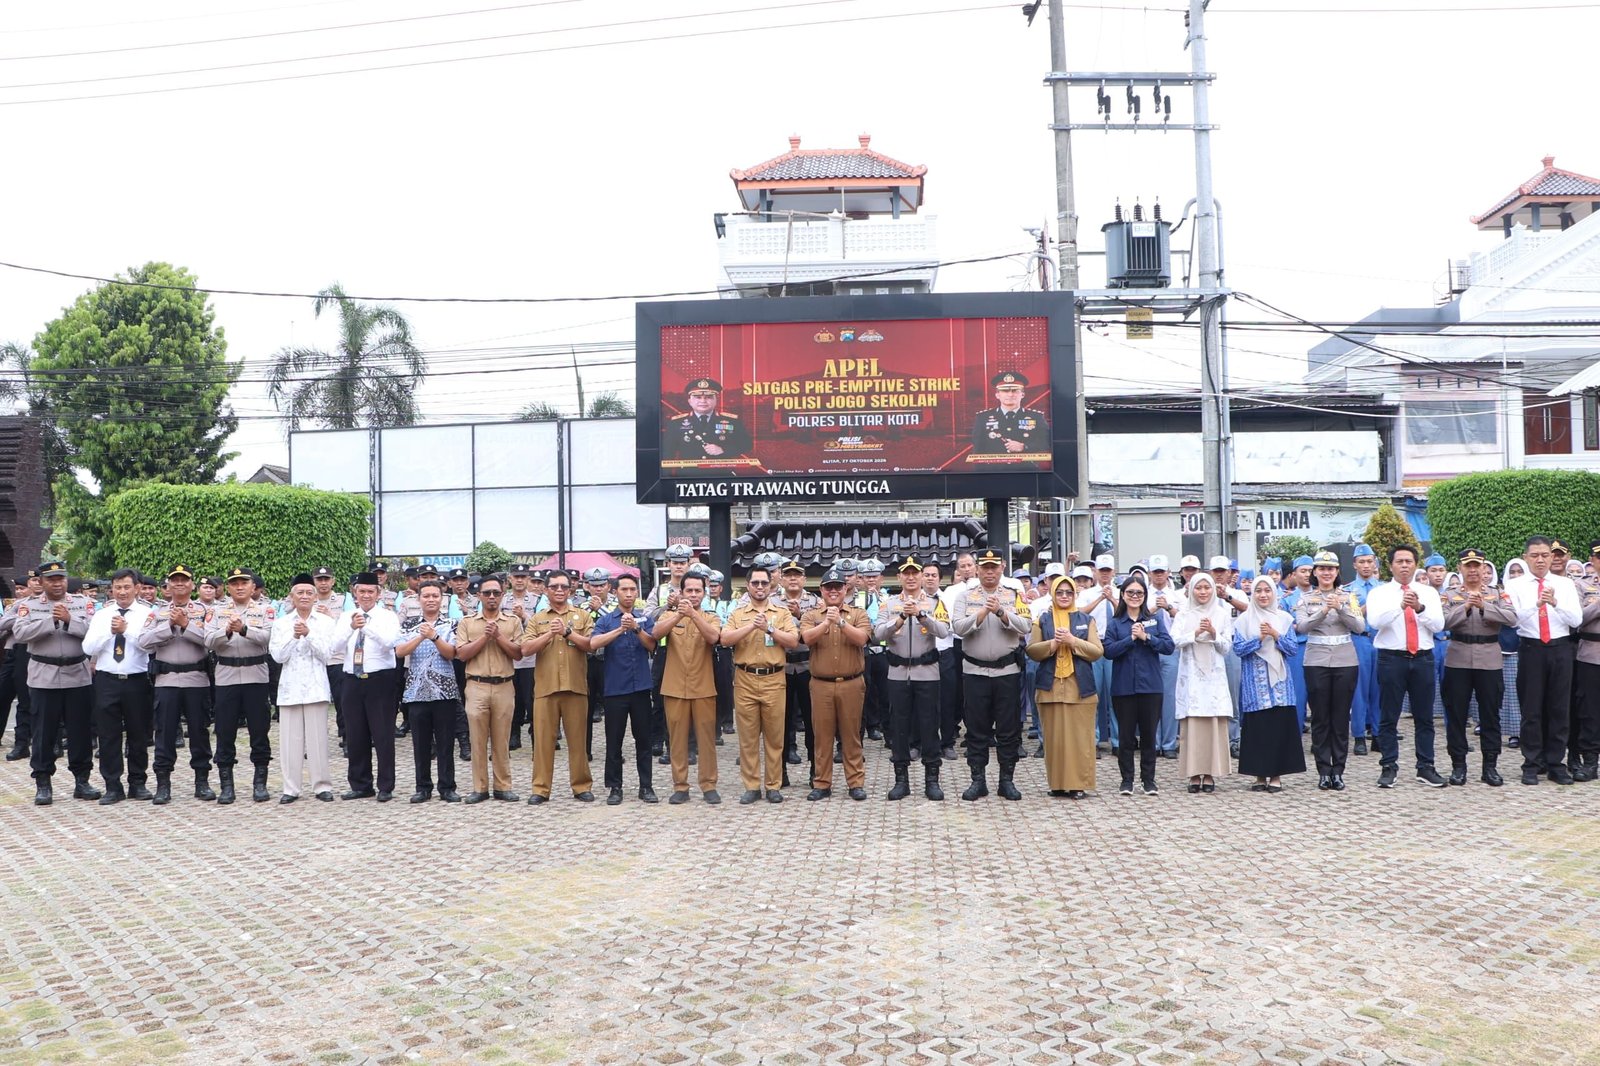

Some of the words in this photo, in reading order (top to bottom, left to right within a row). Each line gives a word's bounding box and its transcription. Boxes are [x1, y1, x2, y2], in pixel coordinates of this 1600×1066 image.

[823, 358, 883, 378] APEL
[743, 381, 801, 395] SATGAS
[805, 378, 905, 394] PRE-EMPTIVE
[909, 377, 960, 391] STRIKE
[774, 396, 821, 410] POLISI
[826, 394, 866, 409] JOGO
[870, 394, 938, 408] SEKOLAH
[788, 415, 835, 428] POLRES
[839, 414, 883, 427] BLITAR
[887, 413, 920, 426] KOTA
[676, 482, 728, 497] TATAG
[731, 481, 817, 496] TRAWANG
[819, 480, 891, 495] TUNGGA
[1270, 510, 1310, 530] LIMA
